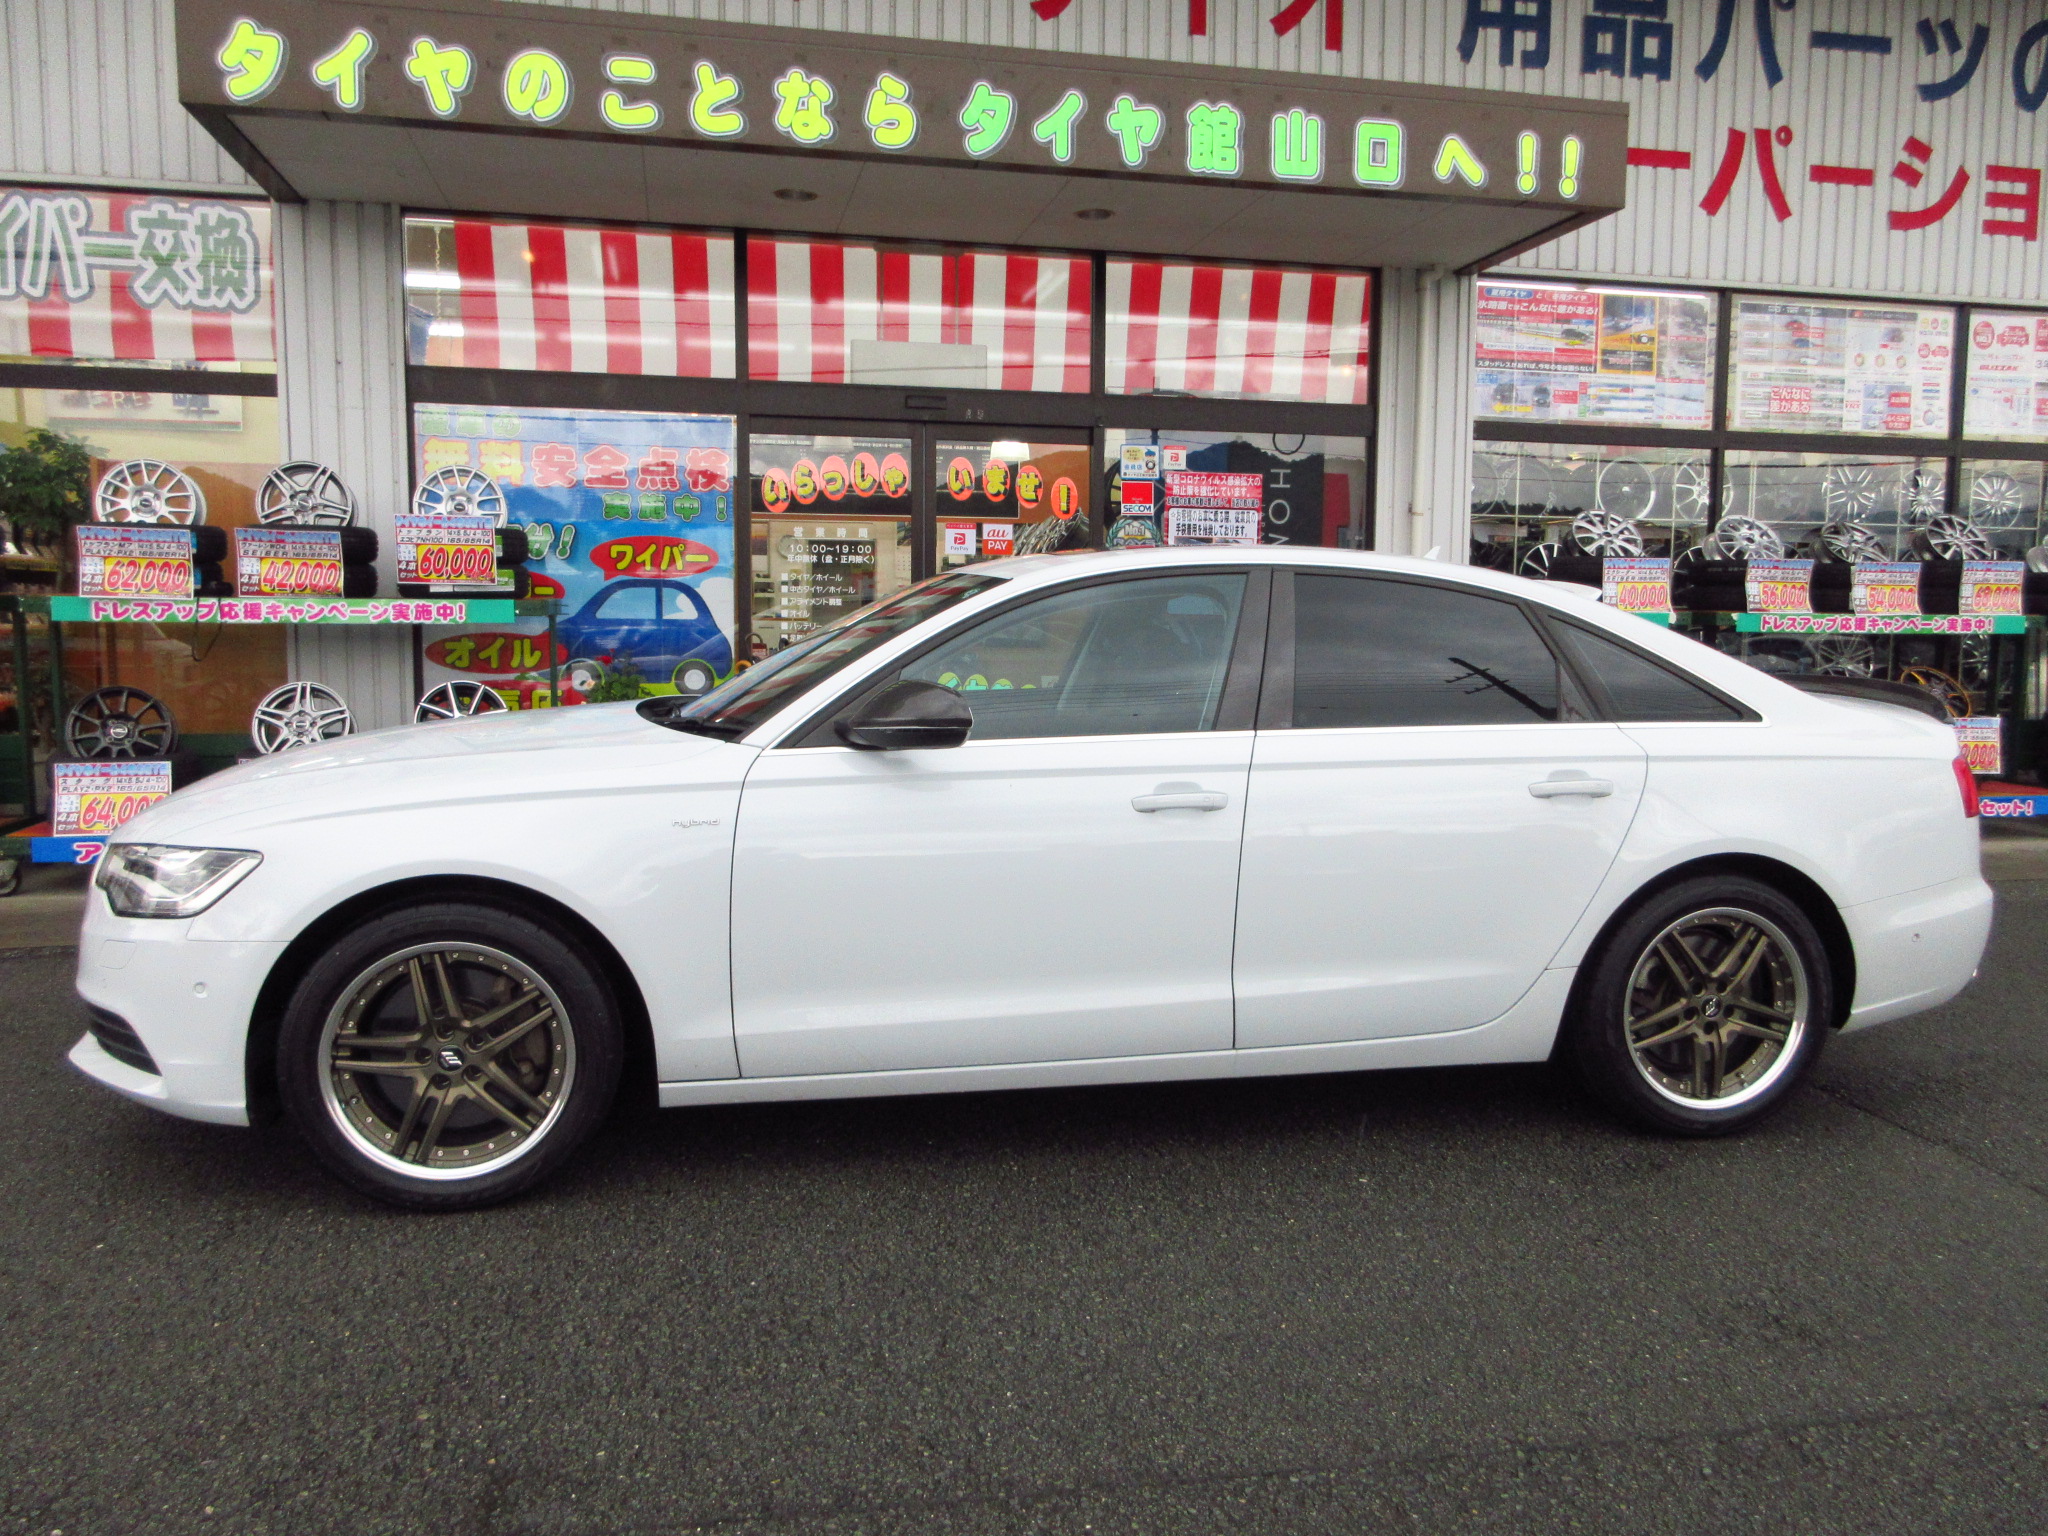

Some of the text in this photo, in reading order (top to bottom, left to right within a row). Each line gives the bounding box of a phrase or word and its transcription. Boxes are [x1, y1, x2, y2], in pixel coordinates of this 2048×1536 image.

[1771, 387, 1811, 400] こんなに
[1770, 400, 1810, 413] 差がある
[422, 437, 731, 492] 無料安全点検
[763, 458, 906, 506] いらっしゃ
[1166, 473, 1261, 486] 新型コロナウイルス感染拡大の
[1172, 485, 1251, 497] 防止策を強化しています。
[1123, 504, 1152, 512] SECOM
[793, 526, 869, 539] 営業時間
[987, 529, 1008, 538] au
[987, 540, 1008, 550] PAY
[419, 546, 492, 579] 60,000
[609, 542, 710, 571] ワイパー
[398, 561, 417, 570] 4本
[81, 574, 103, 583] 4本
[106, 559, 189, 593] 62,000
[240, 574, 259, 583] 4本
[262, 560, 340, 593] 42,000
[1619, 584, 1668, 610] 40,000
[1761, 583, 1807, 609] 56,000
[1867, 586, 1916, 612] 54,000
[91, 600, 467, 622] ドレスアップ応援キャンペーン実施中!
[790, 610, 811, 618] オイル
[789, 621, 823, 630] バッテリー
[1760, 615, 1994, 633] ドレスアップ応援キャンペーン実施中!
[443, 637, 542, 669] オイル
[82, 795, 167, 828] 64,00
[1980, 799, 2034, 816] セット!
[57, 812, 79, 822] 4本
[57, 823, 79, 831] セット
